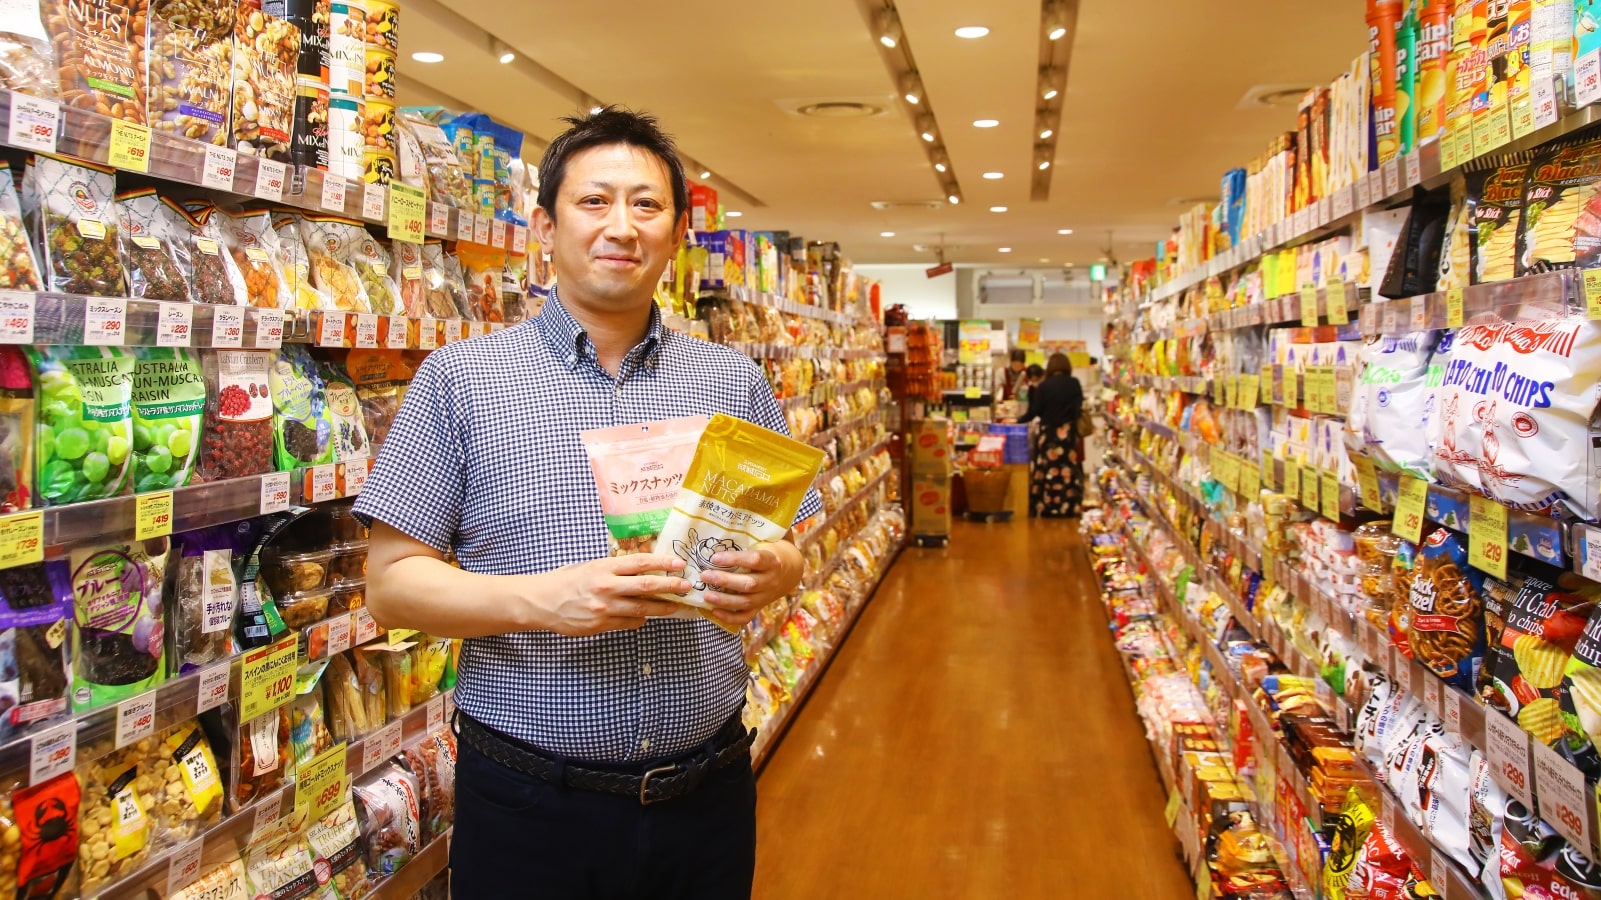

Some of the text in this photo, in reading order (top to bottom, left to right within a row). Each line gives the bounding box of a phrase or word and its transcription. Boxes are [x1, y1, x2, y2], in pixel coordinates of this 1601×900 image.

[69, 0, 122, 34] NUTS
[83, 53, 135, 80] ALMOND
[127, 147, 145, 158] ¥619
[216, 167, 232, 177] ¥690
[268, 179, 282, 189] ¥690
[405, 219, 422, 234] ¥490
[89, 305, 123, 314] ミックスレーズン
[101, 320, 121, 330] ¥290
[170, 325, 188, 334] ¥220
[135, 362, 189, 376] USTRALIA
[1504, 371, 1555, 409] CHIPS
[610, 473, 683, 495] ミックスナッツ
[701, 482, 738, 504] NUTS
[703, 469, 780, 509] MACADAMIA
[153, 514, 169, 525] ¥419
[16, 538, 38, 551] ¥739
[1482, 541, 1502, 563] ¥219
[1526, 592, 1560, 619] Crab
[1516, 615, 1545, 636] chips
[266, 674, 293, 701] ¥1,100
[133, 714, 152, 729] ¥480
[1502, 760, 1525, 790] ¥299
[316, 780, 341, 808] ¥699
[1556, 802, 1583, 837] ¥299
[262, 859, 310, 892] BLANCHE
